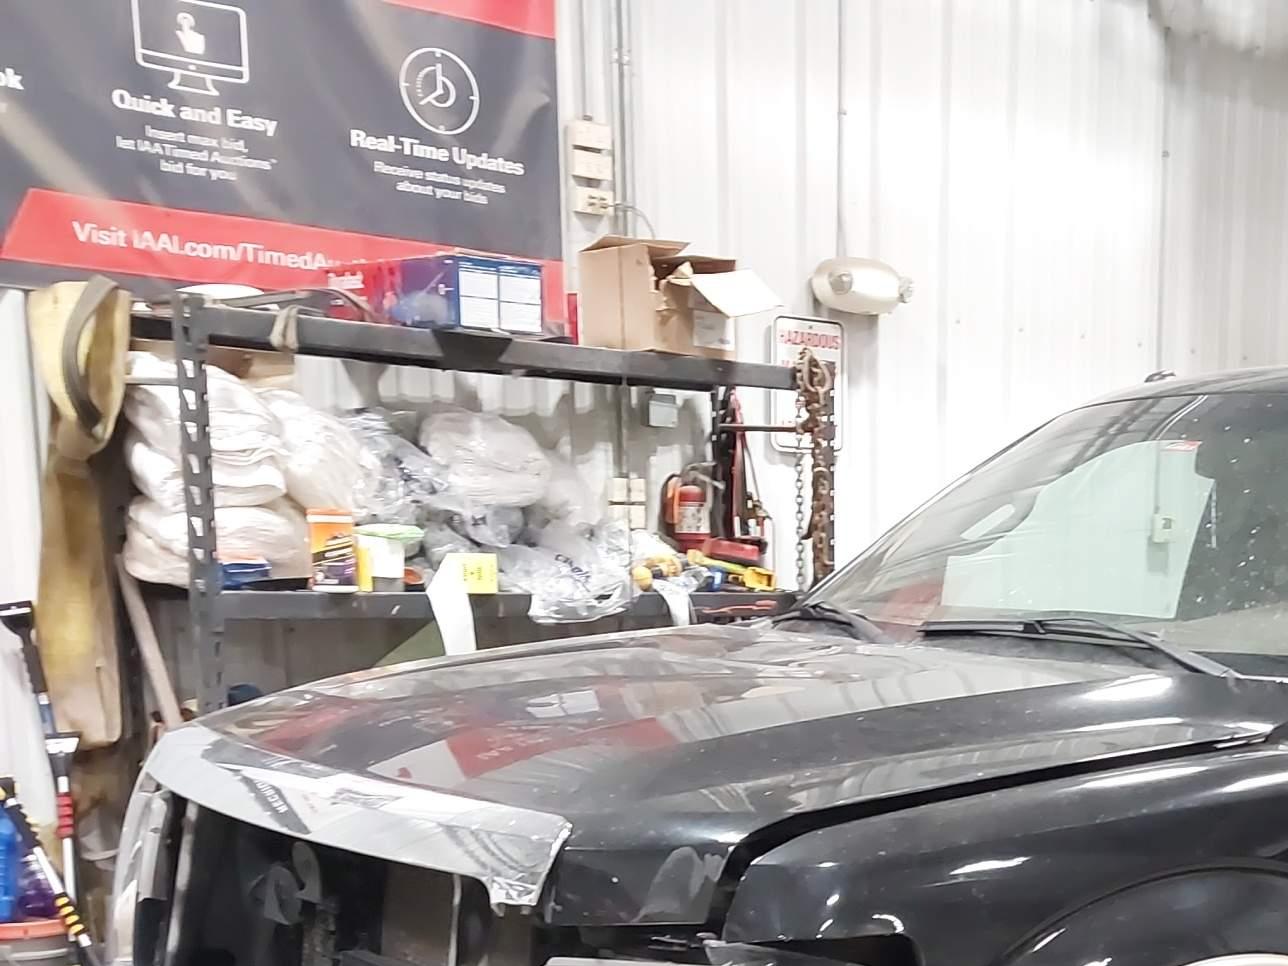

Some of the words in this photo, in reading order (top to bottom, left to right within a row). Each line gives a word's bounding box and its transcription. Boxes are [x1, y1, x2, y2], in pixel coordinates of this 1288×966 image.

[111, 89, 177, 118] Quick
[179, 106, 222, 125] and
[226, 109, 278, 137] Easy
[136, 139, 164, 156] IAA
[161, 143, 209, 162] Timed
[349, 129, 449, 162] Real-Time
[451, 146, 525, 175] Updates
[159, 158, 184, 174] bid
[184, 162, 208, 177] for
[207, 168, 238, 181] you
[373, 160, 424, 180] Receive
[424, 171, 462, 186] status
[461, 178, 506, 194] updates
[395, 180, 434, 196] about
[433, 187, 462, 200] your
[463, 190, 489, 205] bids
[72, 220, 128, 249] Visit
